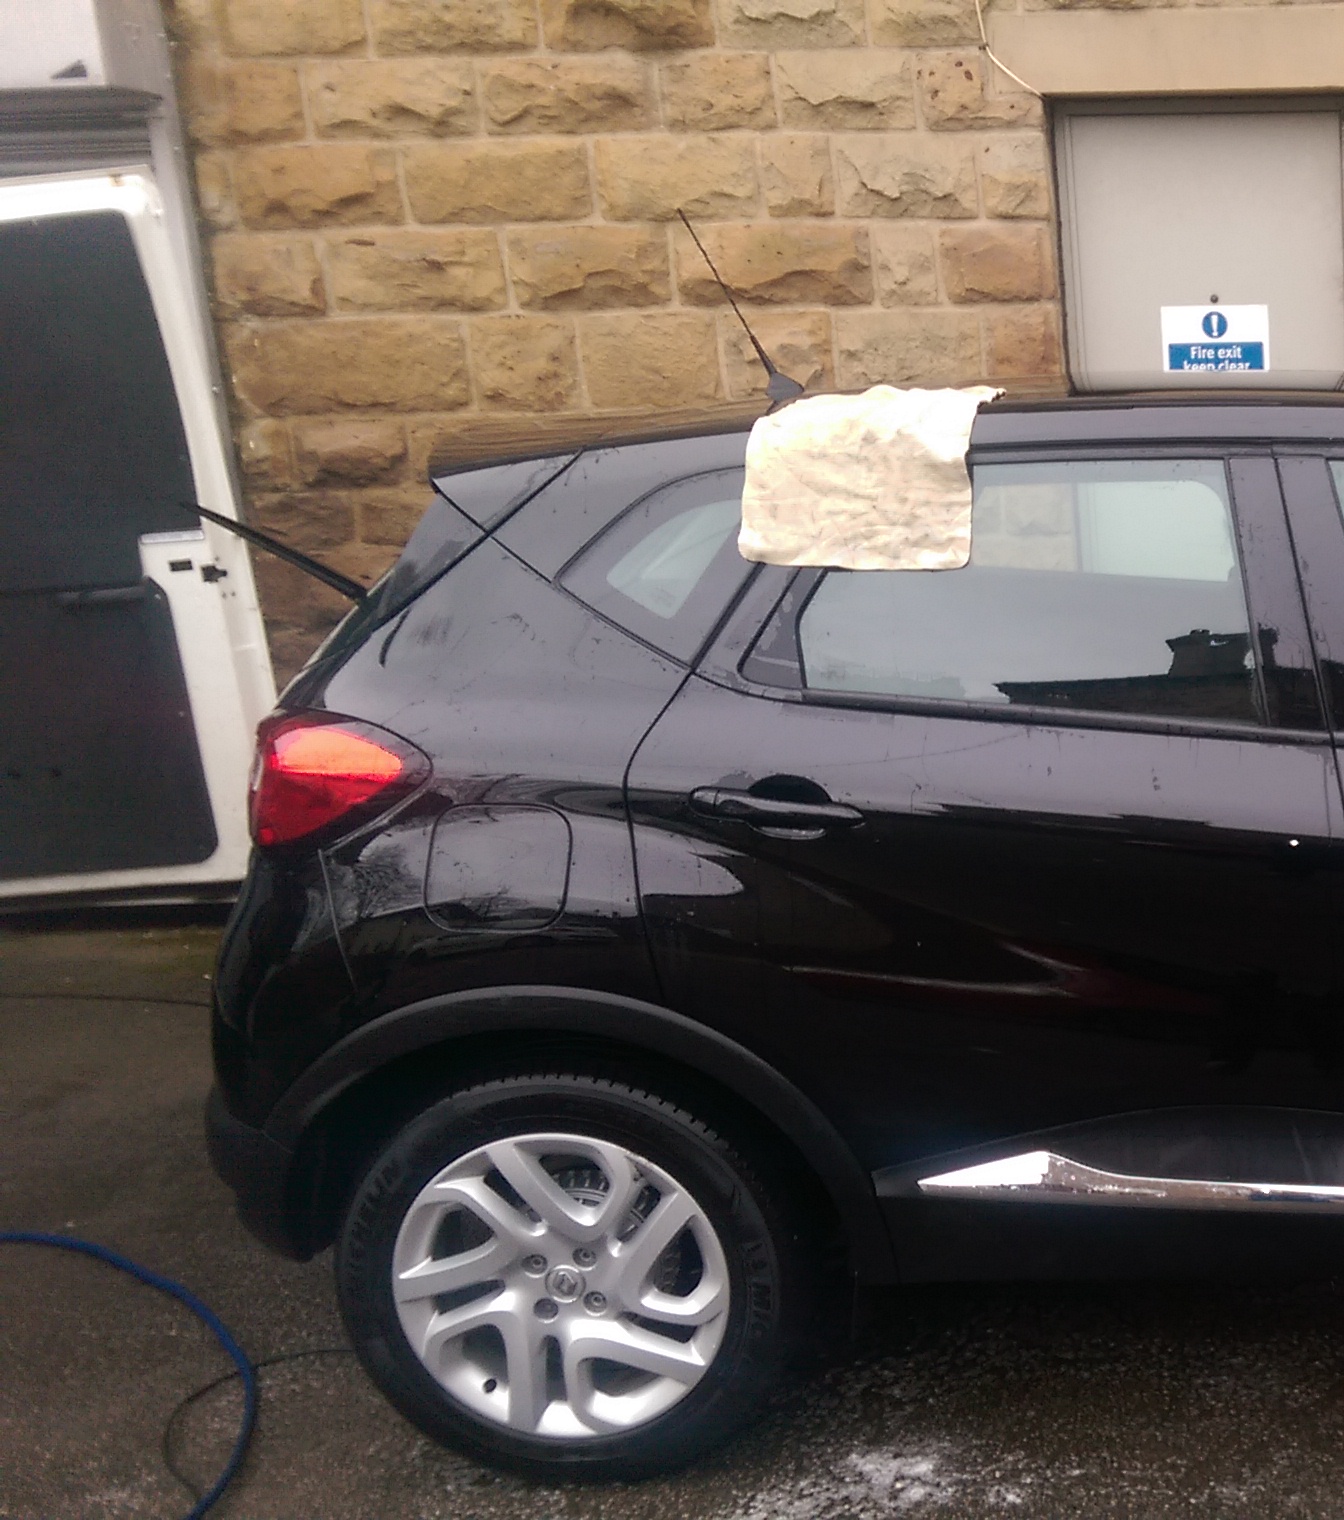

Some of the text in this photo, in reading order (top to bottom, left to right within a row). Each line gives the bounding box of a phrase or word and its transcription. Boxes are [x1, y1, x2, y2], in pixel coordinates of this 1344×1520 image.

[1190, 345, 1242, 359] Fire exit
[1217, 359, 1250, 370] clear
